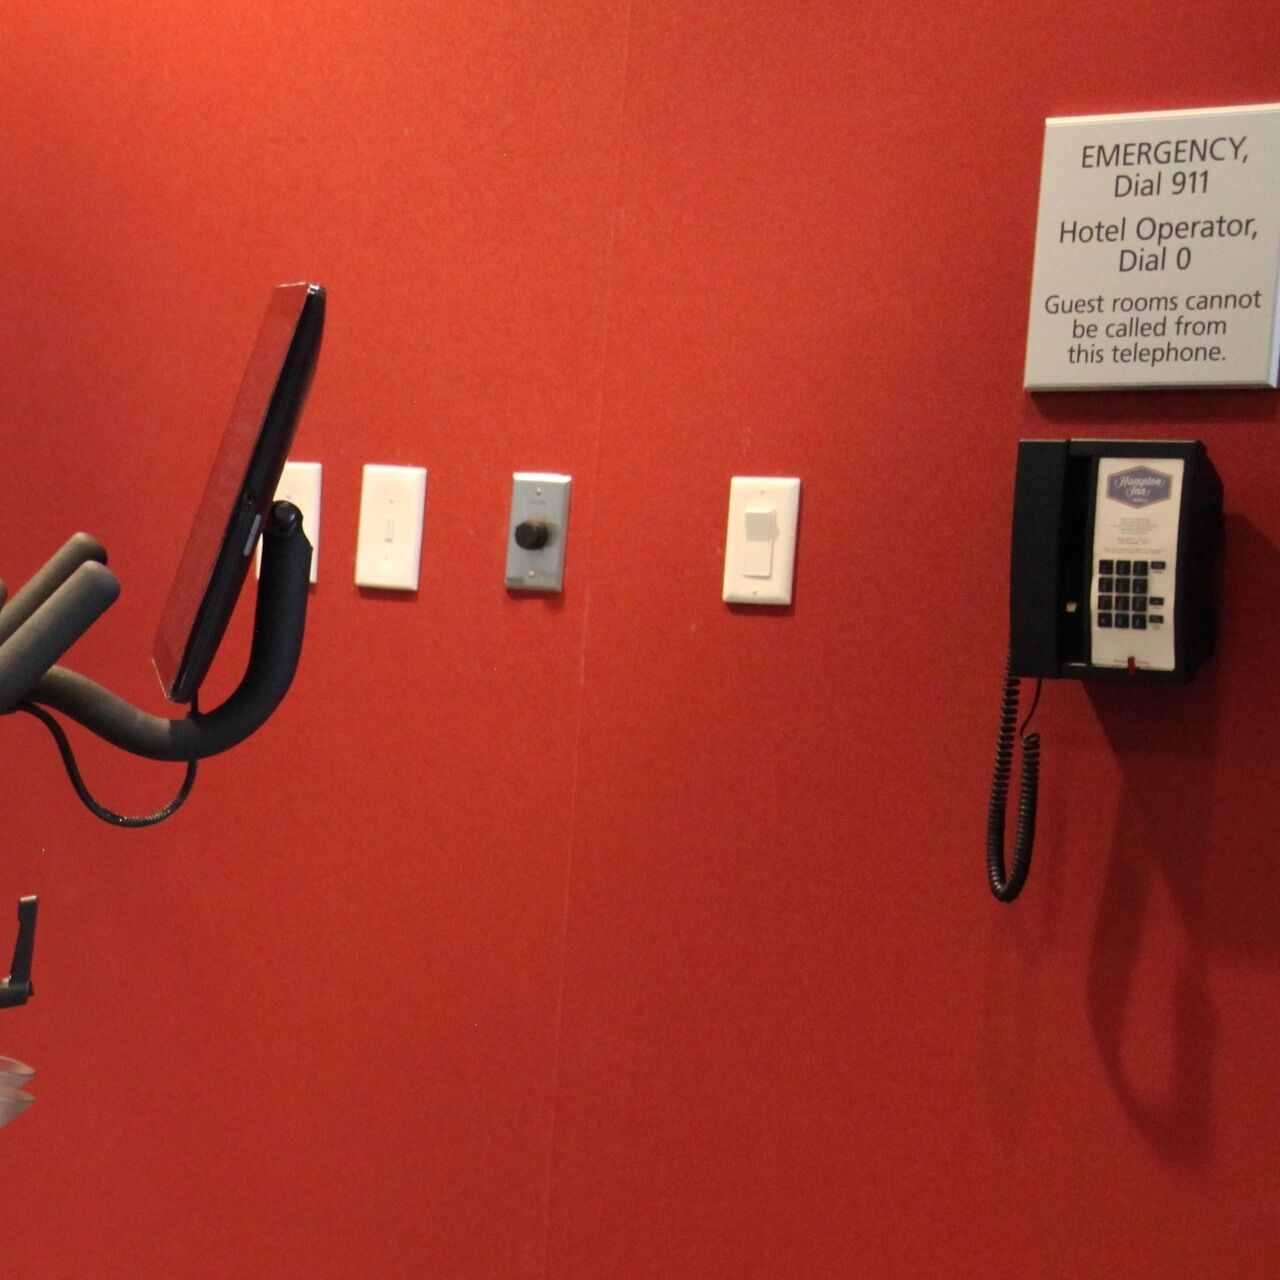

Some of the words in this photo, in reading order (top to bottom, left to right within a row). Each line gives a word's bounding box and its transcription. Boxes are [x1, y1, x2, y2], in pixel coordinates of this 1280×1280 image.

[1081, 136, 1248, 168] EMERGENCY,
[1114, 172, 1161, 198] Dial
[1172, 170, 1208, 195] 911
[1059, 216, 1126, 244] Hotel
[1136, 215, 1258, 246] Operator,
[1119, 246, 1166, 272] Dial
[1176, 246, 1192, 270] 0
[1044, 294, 1104, 314] Guest
[1111, 295, 1178, 312] rooms
[1185, 290, 1262, 311] cannot
[1072, 319, 1098, 338] be
[1105, 316, 1166, 337] called
[1175, 315, 1227, 336] from
[1068, 342, 1104, 364] this
[1112, 342, 1227, 367] telephone.
